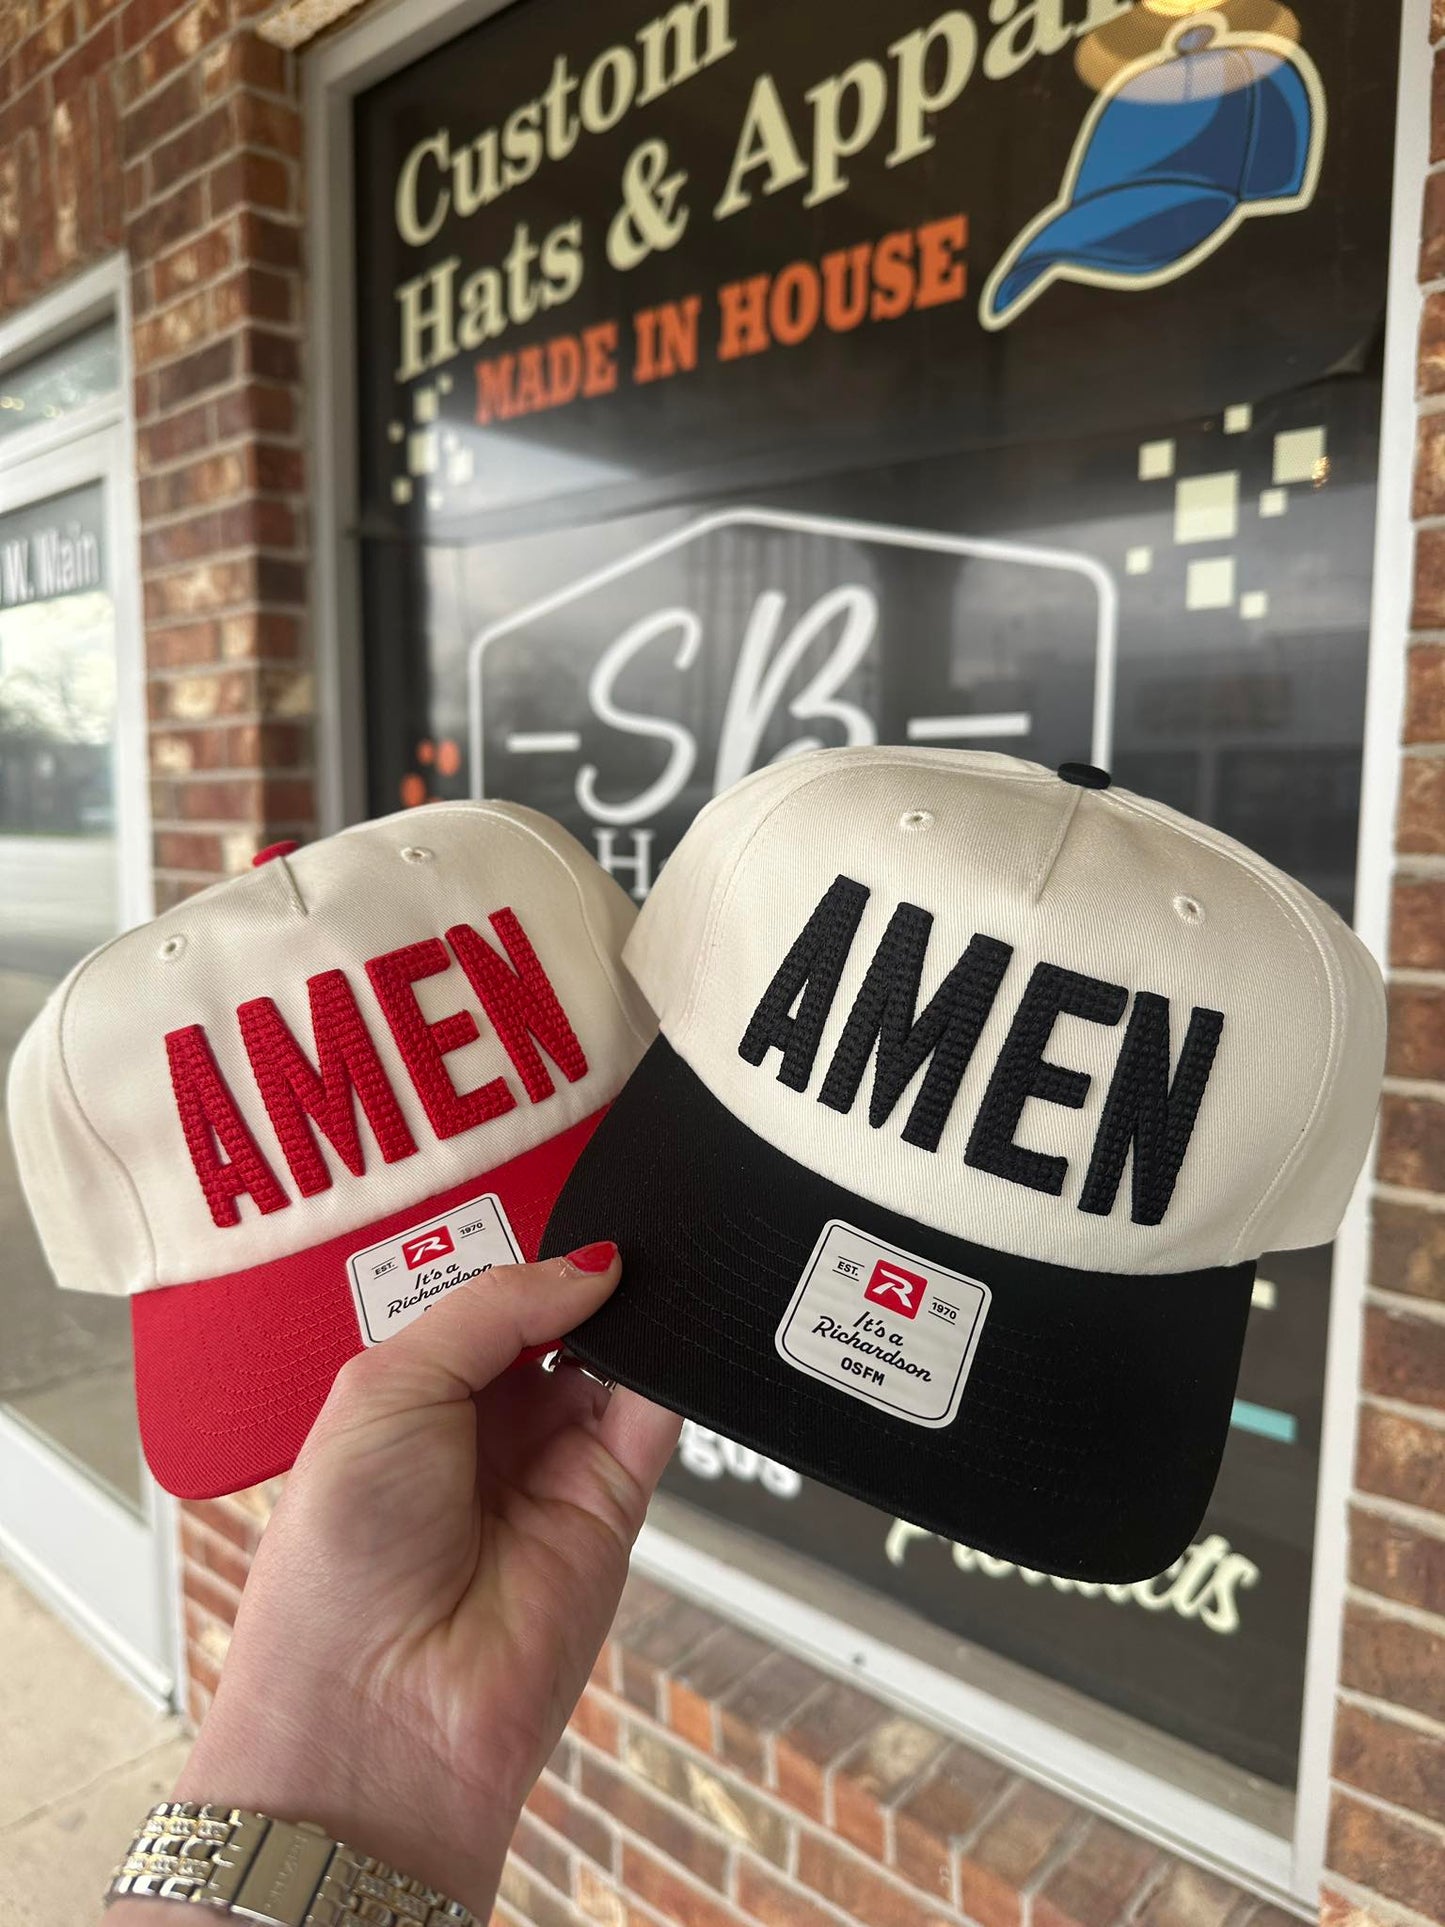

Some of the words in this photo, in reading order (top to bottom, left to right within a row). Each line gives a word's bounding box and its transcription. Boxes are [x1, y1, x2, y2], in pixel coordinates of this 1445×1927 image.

[395, 0, 737, 247] Custom
[395, 215, 584, 383] Hats
[605, 137, 690, 272] &
[474, 320, 619, 426] MADE
[633, 293, 701, 384] IN
[717, 214, 968, 362] HOUSE
[33, 521, 101, 598] Main
[164, 906, 589, 1228] AMEN
[738, 874, 1225, 1226] AMEN
[374, 1262, 396, 1276] EST.
[459, 1221, 484, 1236] 1970
[414, 1269, 442, 1290] It's
[446, 1263, 460, 1275] a
[387, 1263, 493, 1319] Richardson
[836, 1261, 859, 1277] EST.
[931, 1302, 957, 1321] 1970
[811, 1315, 932, 1383] Richardson
[853, 1311, 886, 1338] It's
[888, 1332, 904, 1347] a
[840, 1356, 886, 1387] OSFM
